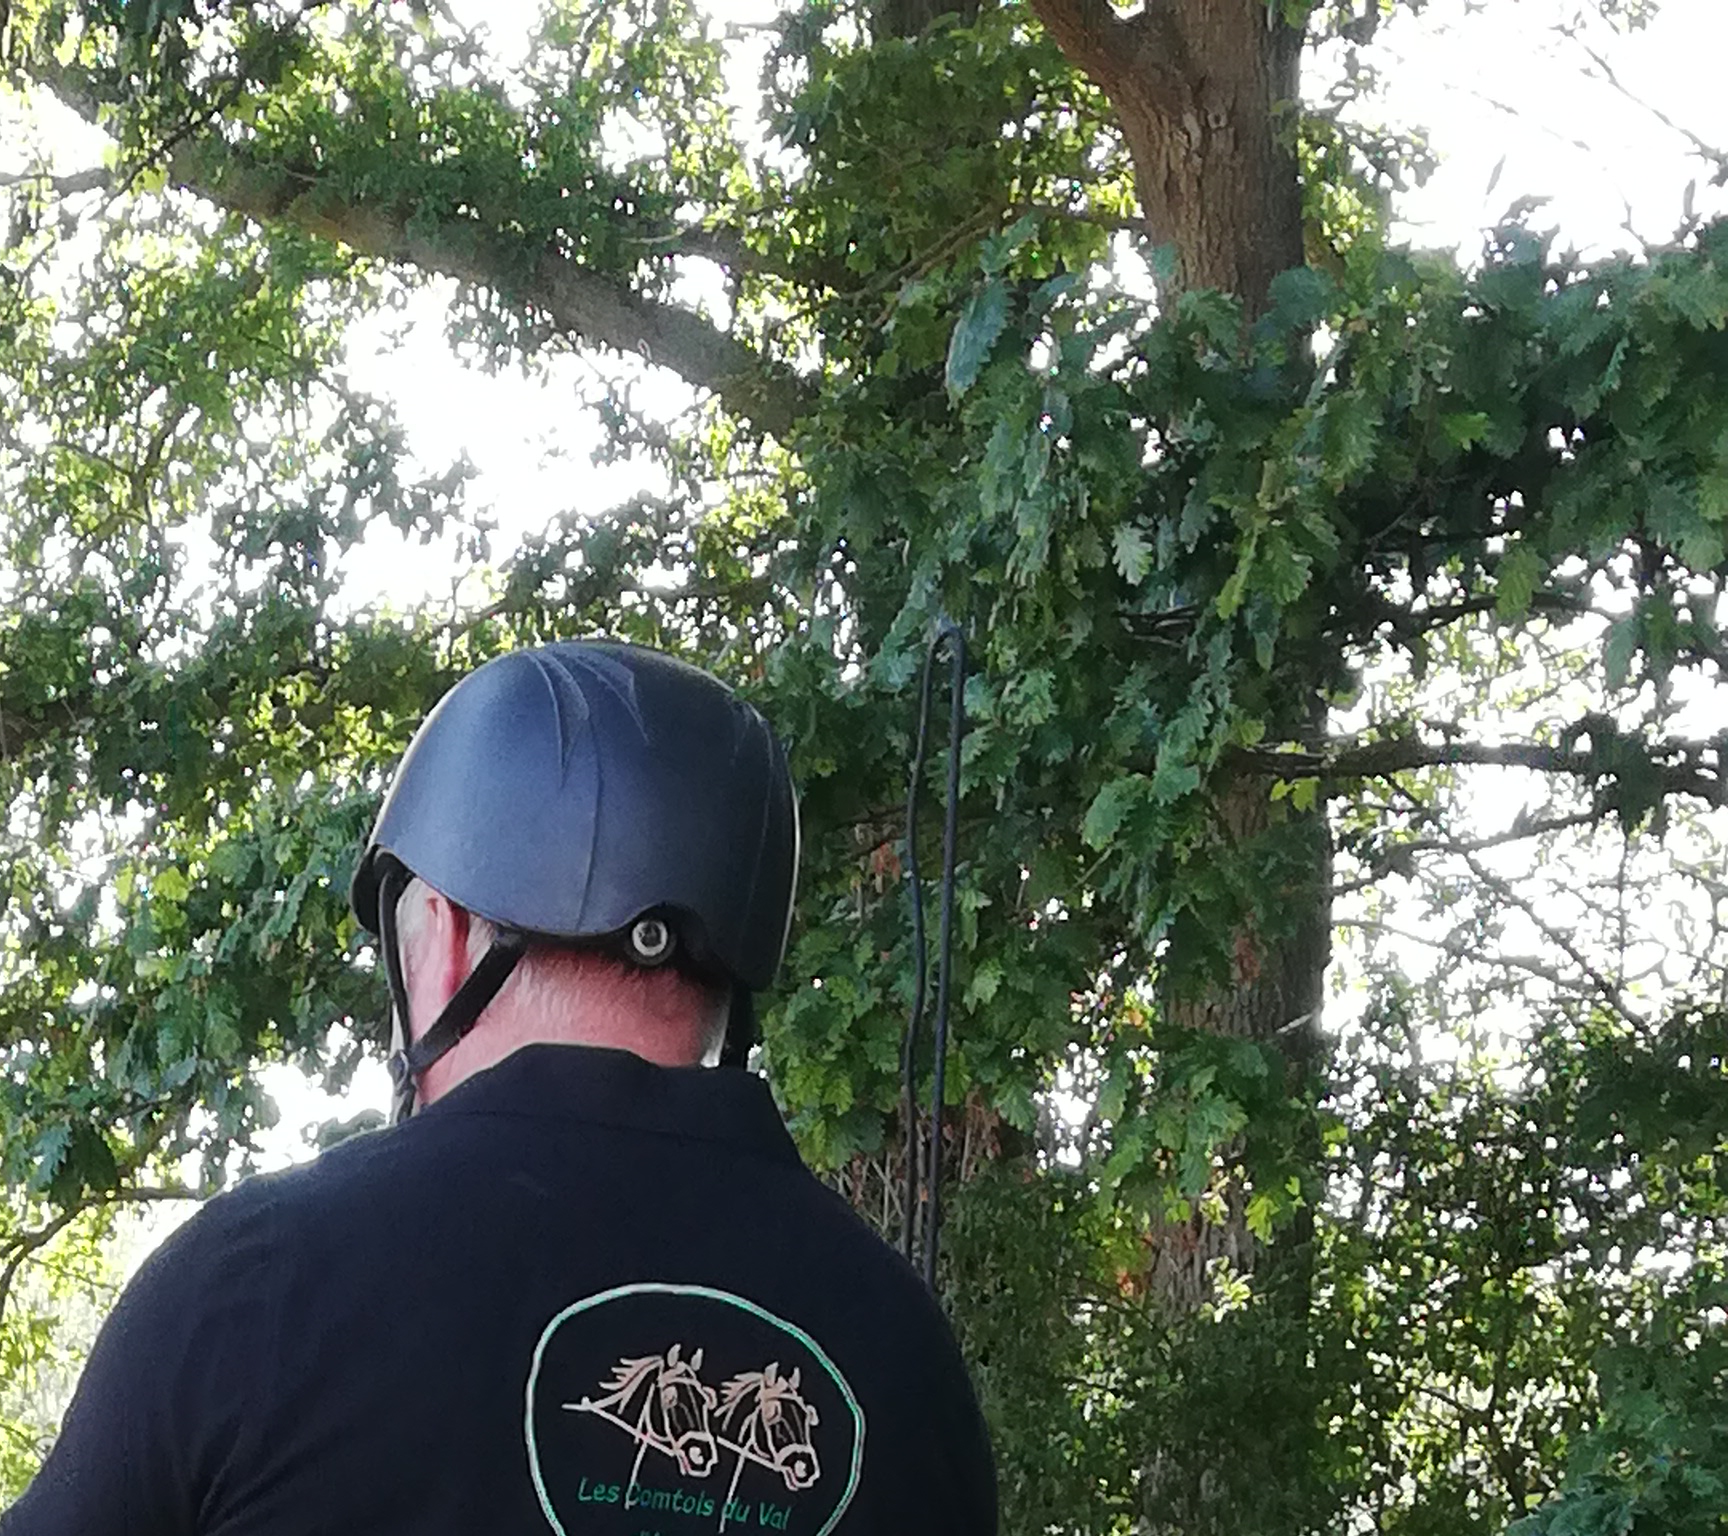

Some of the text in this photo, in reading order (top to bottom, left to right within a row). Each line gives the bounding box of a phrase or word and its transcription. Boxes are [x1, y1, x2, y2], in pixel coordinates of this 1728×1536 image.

[578, 1477, 792, 1530] Les Comtois du Val
